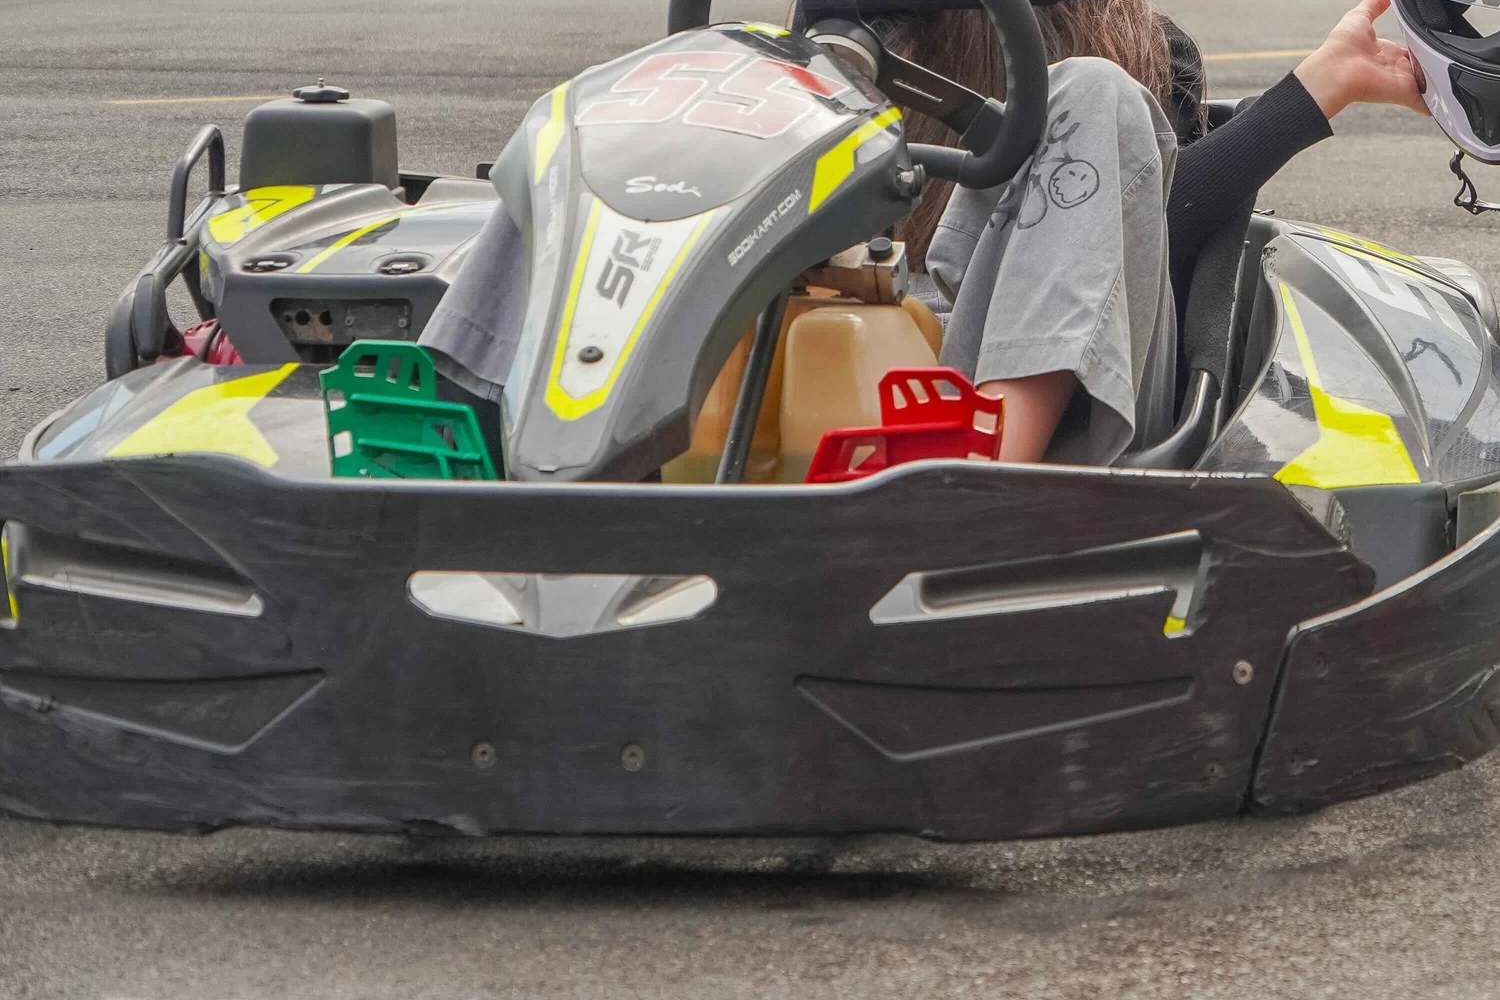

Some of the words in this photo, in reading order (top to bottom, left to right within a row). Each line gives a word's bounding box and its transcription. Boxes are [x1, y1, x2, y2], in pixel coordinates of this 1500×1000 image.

[574, 51, 851, 139] 55
[625, 176, 702, 198] Sodi
[727, 188, 802, 267] SODIKART.COM
